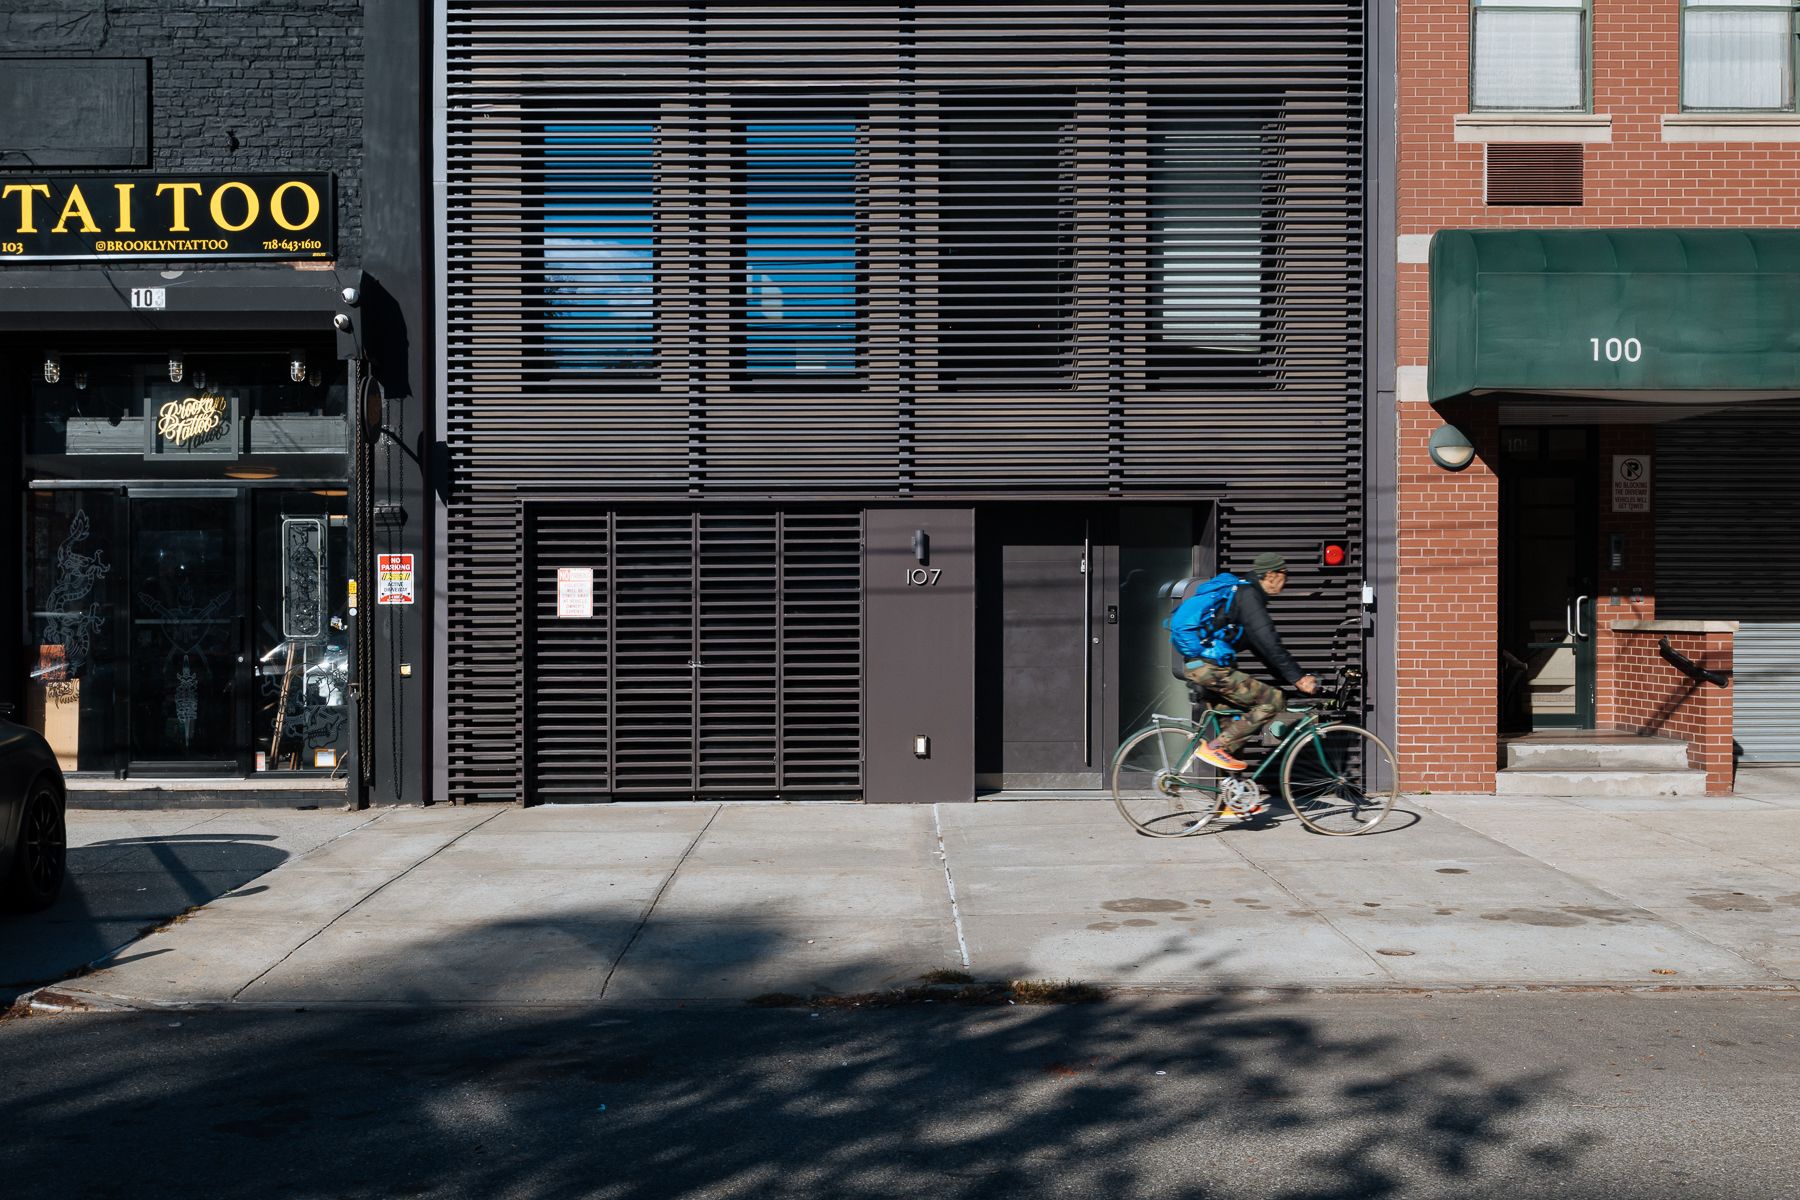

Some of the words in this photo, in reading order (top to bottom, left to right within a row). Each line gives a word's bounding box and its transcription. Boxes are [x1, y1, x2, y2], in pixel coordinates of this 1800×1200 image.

[2, 242, 24, 255] 103
[1590, 337, 1642, 362] 100
[1614, 481, 1623, 489] NO
[390, 557, 402, 565] NO
[381, 563, 411, 571] PARKING
[906, 568, 941, 585] 107
